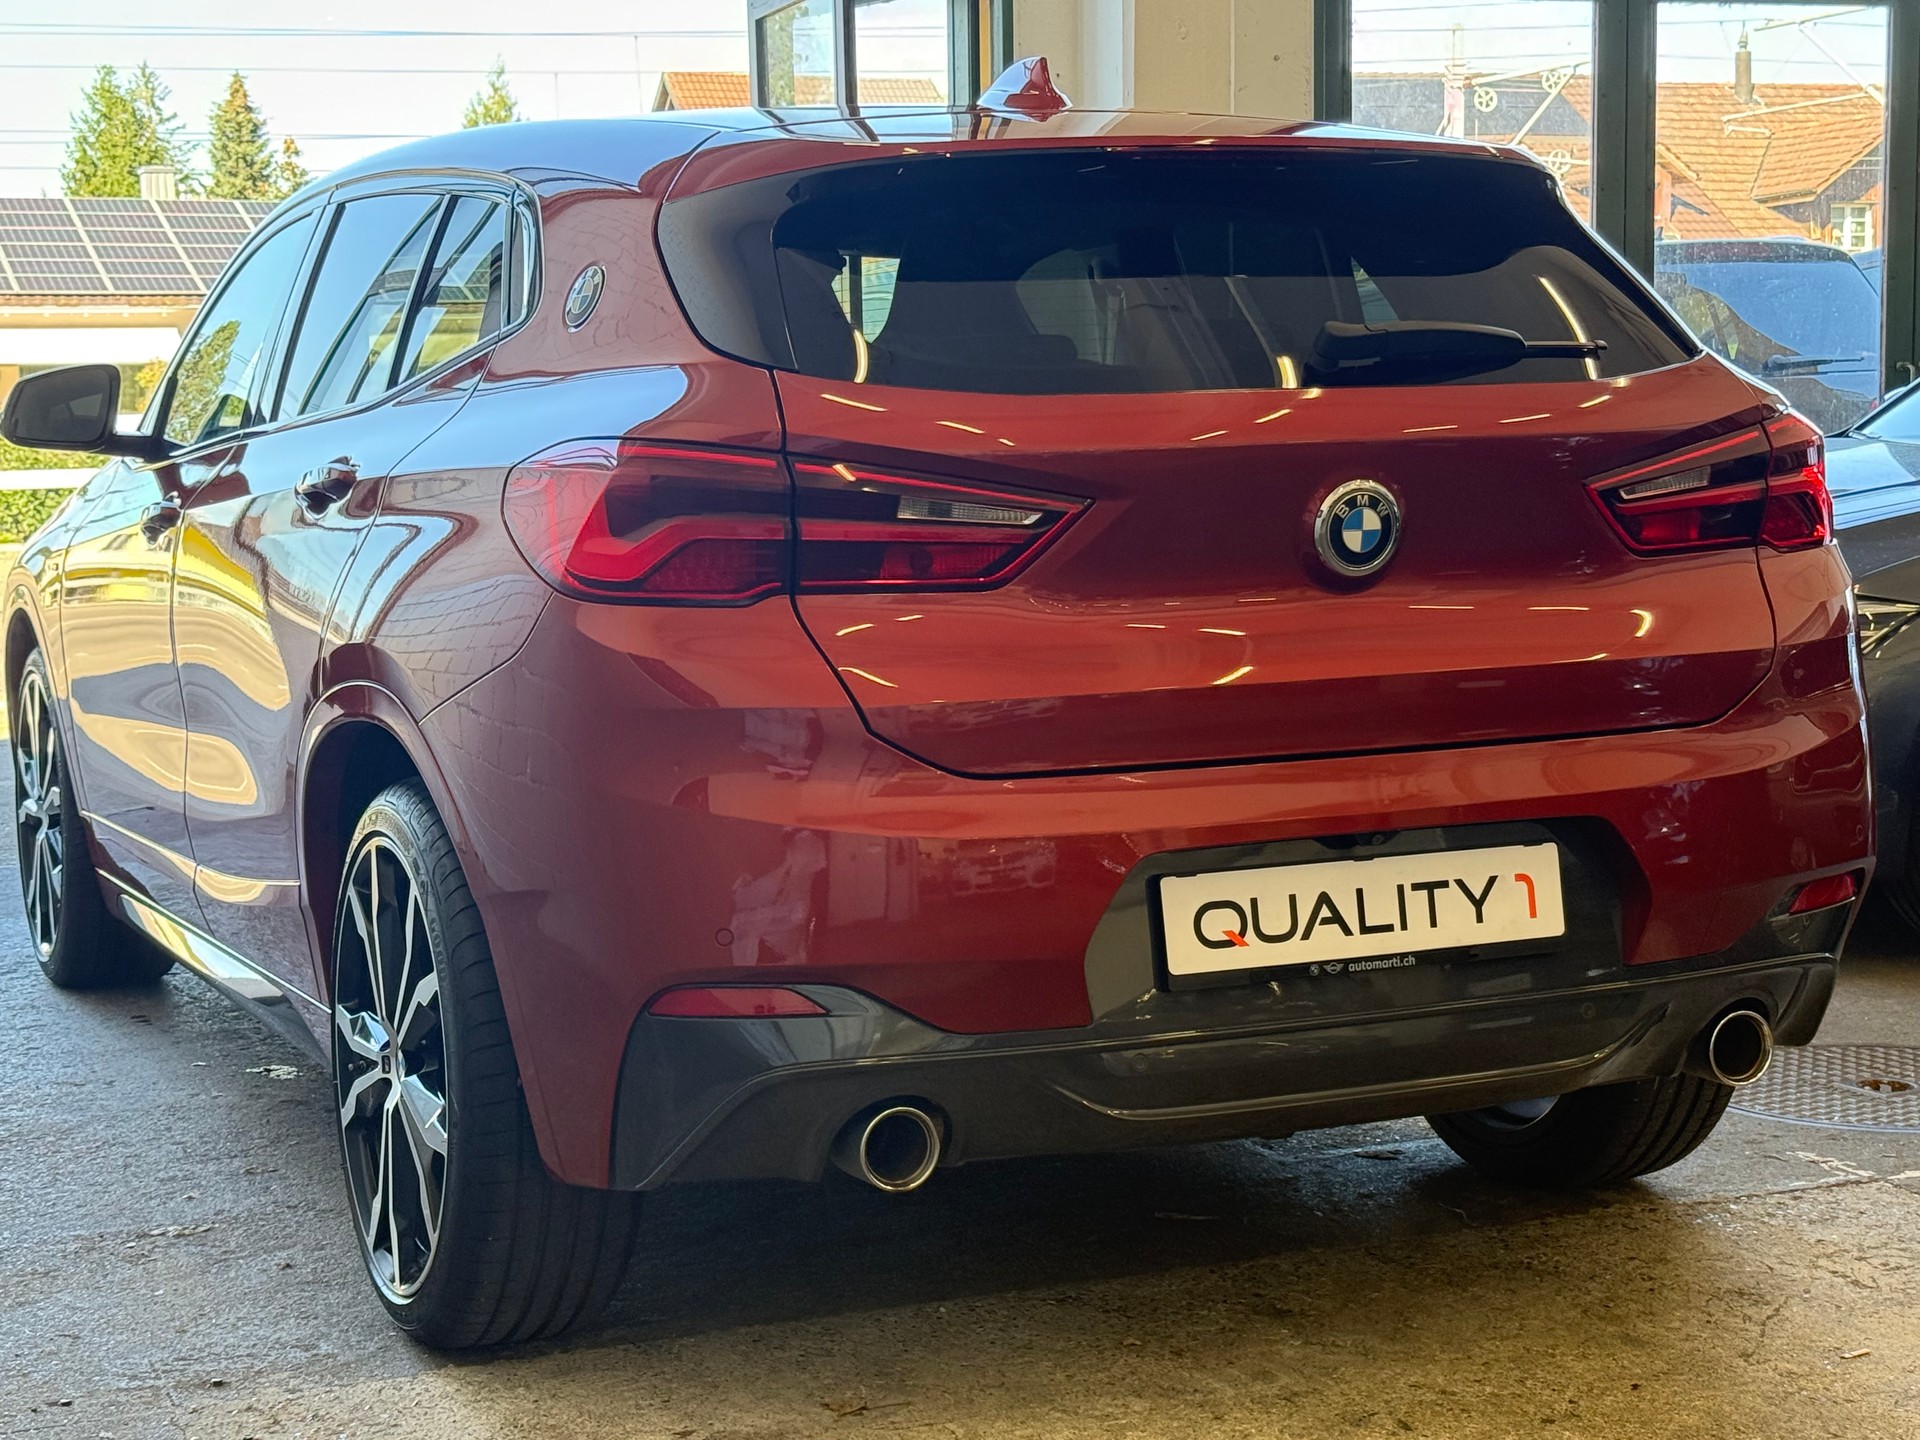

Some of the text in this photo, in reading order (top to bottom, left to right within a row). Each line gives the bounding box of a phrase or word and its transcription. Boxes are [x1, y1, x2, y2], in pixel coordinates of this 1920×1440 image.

[1336, 494, 1389, 519] BMW
[1193, 873, 1537, 949] QUALITY 1
[1348, 955, 1416, 972] automarti.ch
